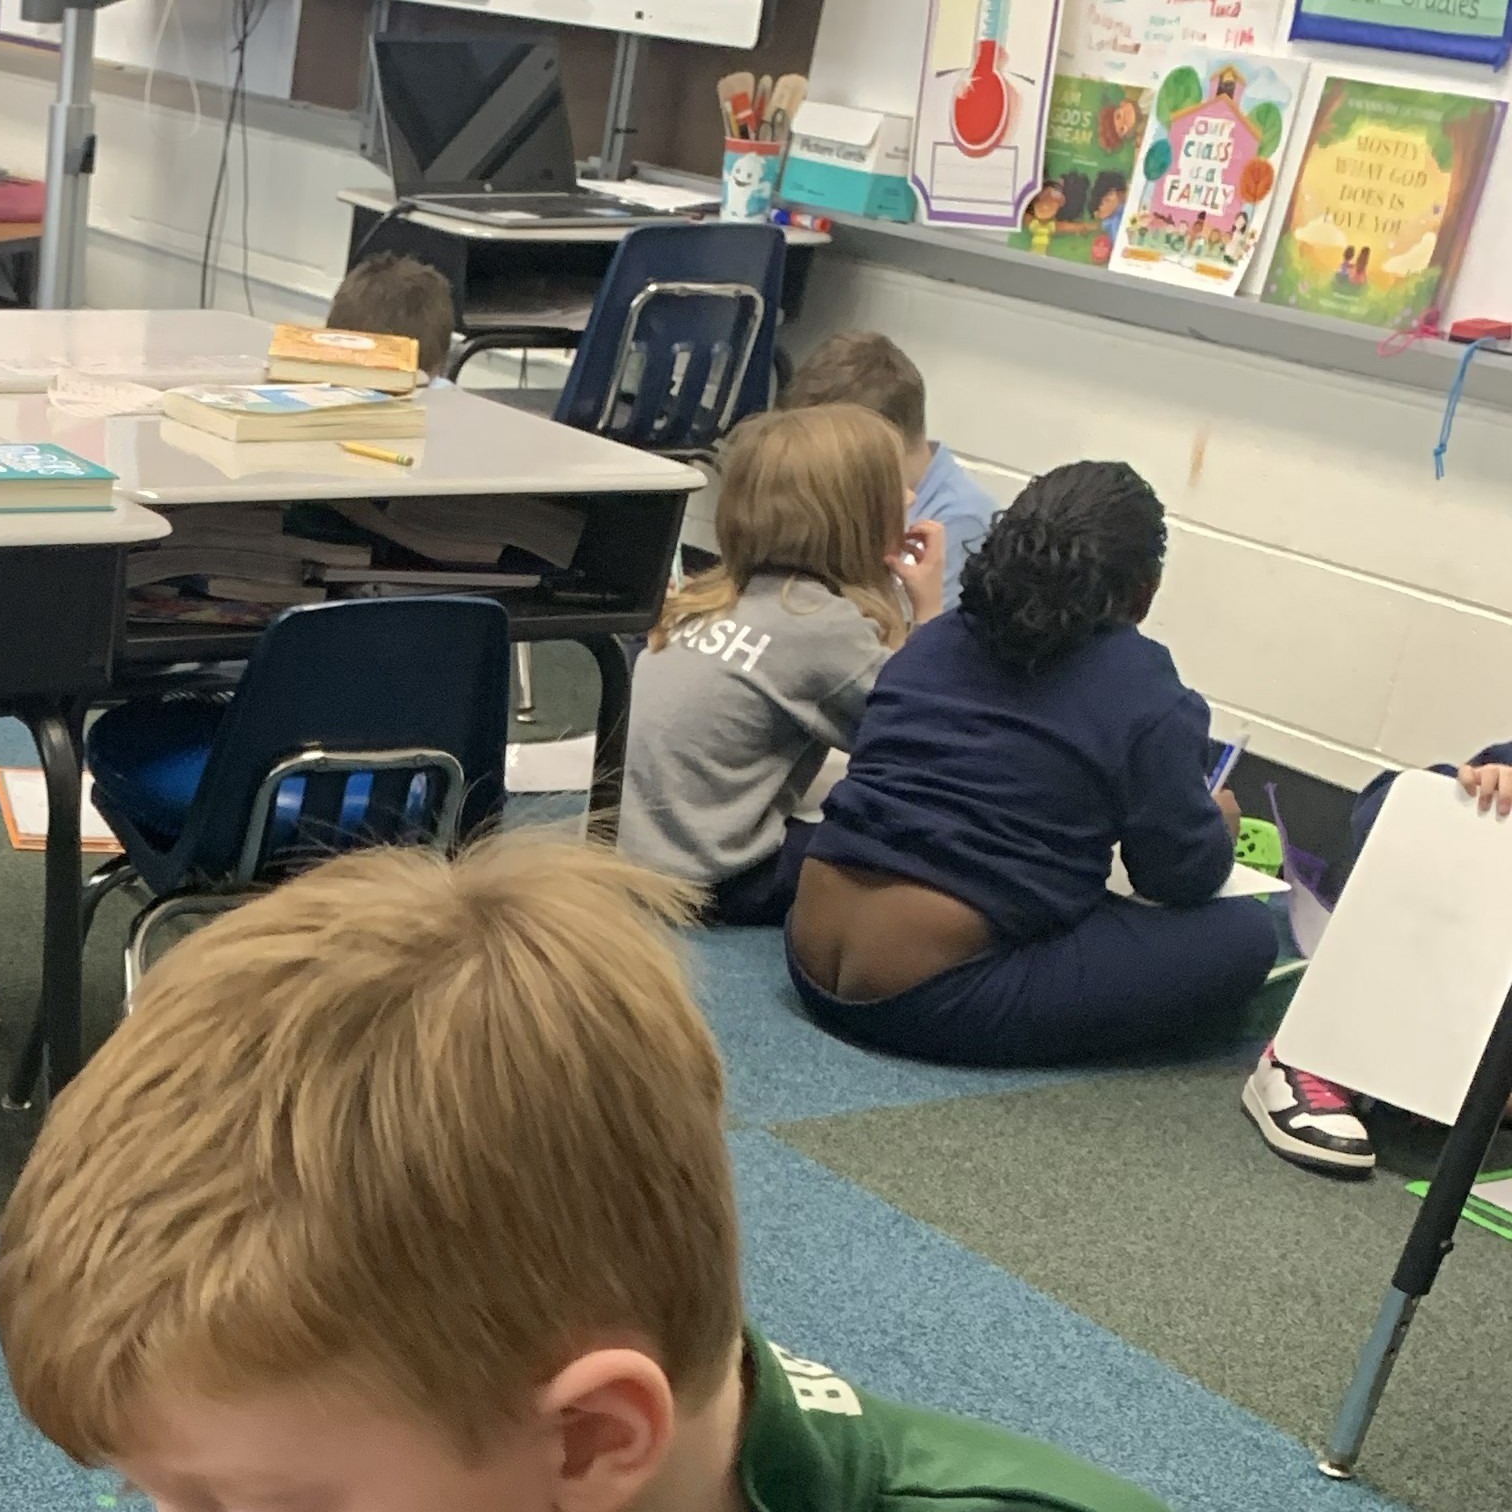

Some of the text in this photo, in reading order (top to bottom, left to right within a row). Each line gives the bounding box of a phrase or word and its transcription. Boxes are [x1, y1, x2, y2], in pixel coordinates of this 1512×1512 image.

[1357, 135, 1420, 161] MOSTLY
[1335, 156, 1428, 189] WHAT GOD
[1166, 181, 1235, 210] FAMILY
[1339, 184, 1406, 212] DOES IS
[1323, 207, 1405, 236] LOVE YOU
